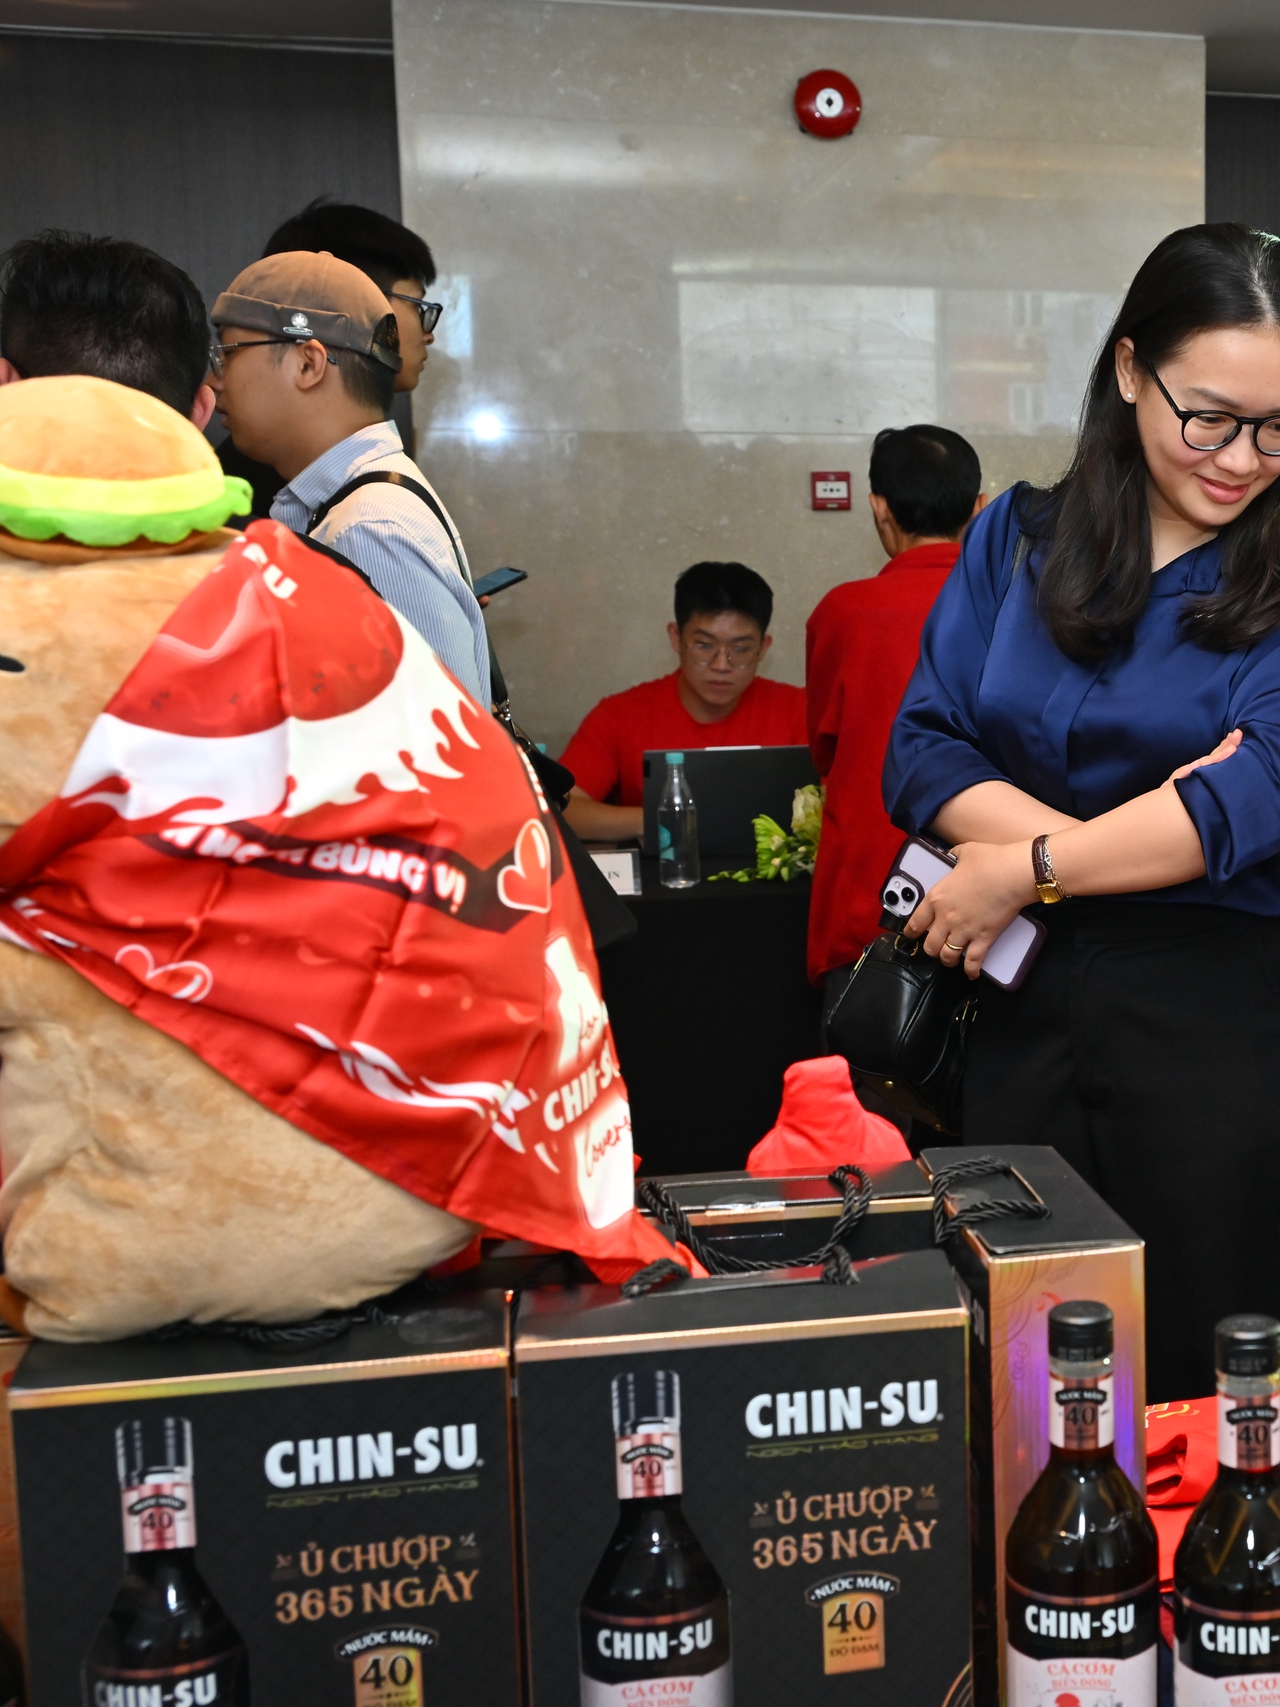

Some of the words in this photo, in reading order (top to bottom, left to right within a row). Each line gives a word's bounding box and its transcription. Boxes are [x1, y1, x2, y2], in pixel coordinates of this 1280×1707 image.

[311, 838, 428, 893] BÙNG
[433, 861, 467, 914] VỊ
[543, 1038, 622, 1132] CHIN-S
[744, 1379, 940, 1439] CHIN-SU
[1066, 1405, 1095, 1426] 40
[264, 1423, 479, 1488] CHIN-SU
[1238, 1425, 1268, 1446] 40
[634, 1460, 662, 1478] 40
[142, 1511, 173, 1531] 40
[775, 1491, 797, 1524] Ủ
[803, 1484, 914, 1523] CHƯỢP
[300, 1542, 324, 1578] Ủ
[330, 1535, 452, 1573] CHƯỢP
[752, 1531, 824, 1569] 365
[831, 1514, 938, 1560] NGÀY
[274, 1585, 354, 1625] 365
[361, 1566, 480, 1615] NGÀY
[827, 1600, 877, 1634] 40
[1025, 1603, 1135, 1640] CHIN-SU
[597, 1618, 714, 1661] CHIN-SU
[94, 1672, 217, 1707] CHIN-SU
[359, 1655, 414, 1690] 40
